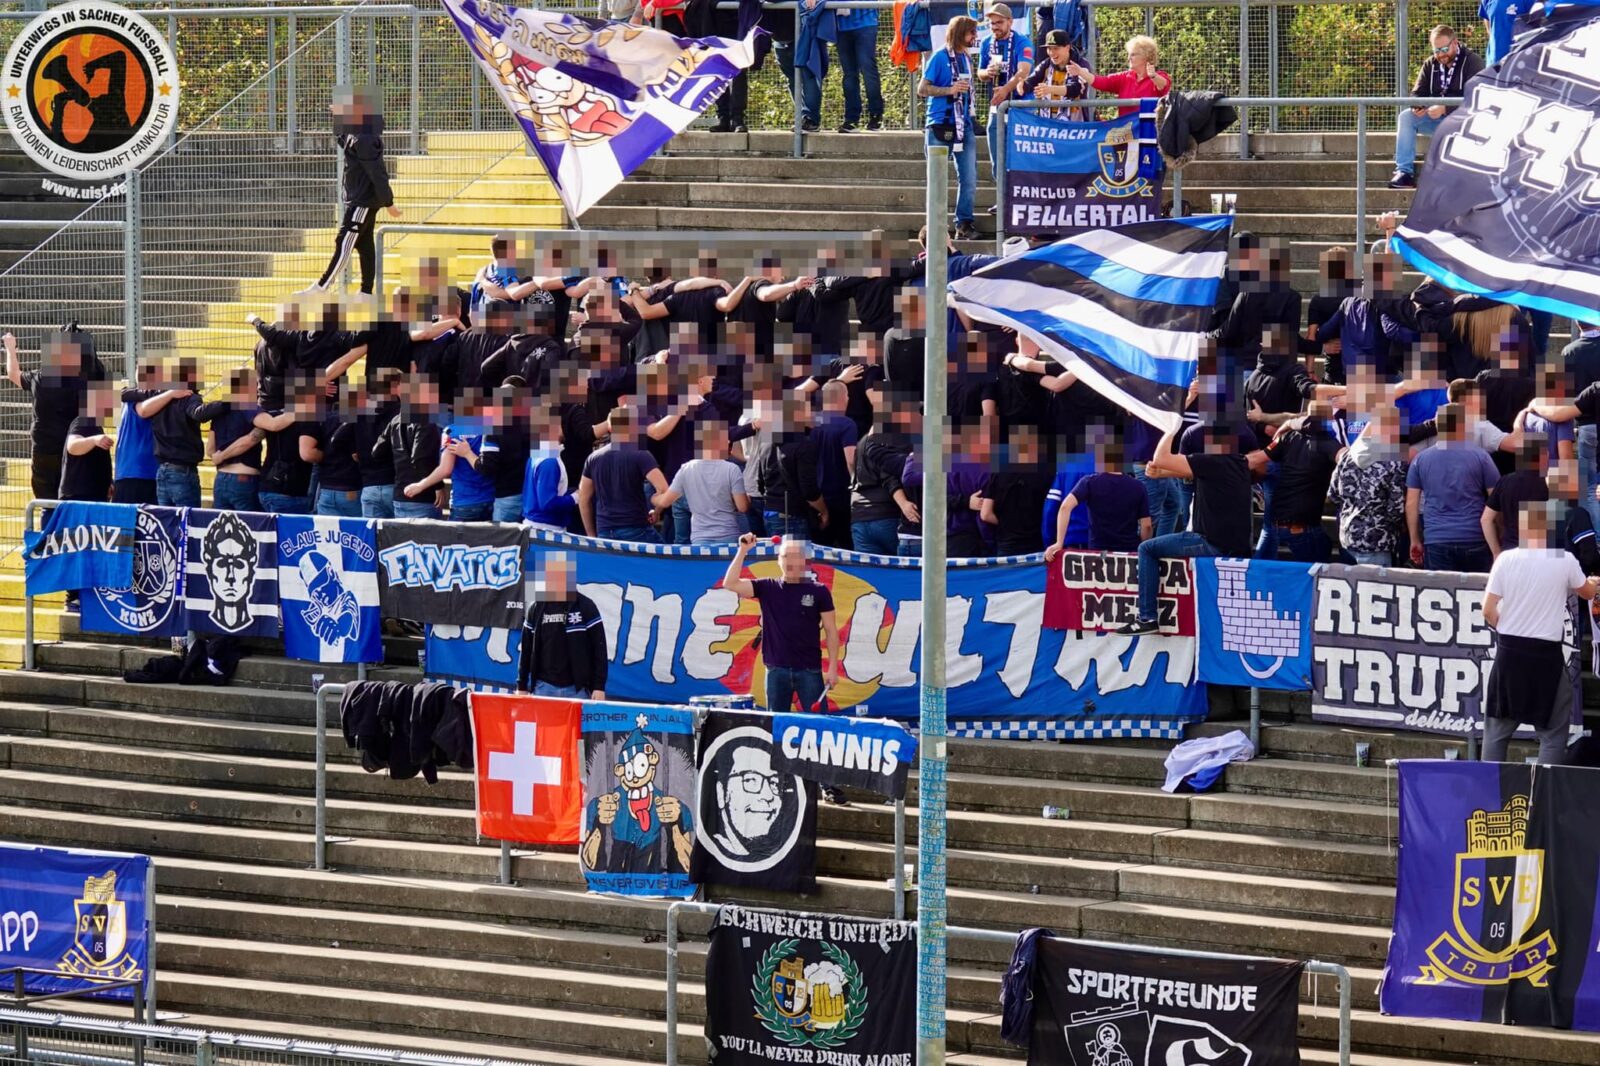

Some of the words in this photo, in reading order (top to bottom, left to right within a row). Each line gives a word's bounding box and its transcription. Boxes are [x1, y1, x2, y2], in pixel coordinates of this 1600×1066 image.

[1014, 123, 1097, 140] EINTRACHT
[1014, 140, 1055, 155] TRIER
[1013, 185, 1077, 199] FANCLUB
[1011, 204, 1155, 227] FELLERTAL
[279, 530, 322, 558] BLAUE
[325, 530, 375, 562] JUGEND
[120, 608, 157, 626] KONZ
[1082, 591, 1179, 634] MEZ
[1313, 645, 1495, 715] TRUP
[1405, 709, 1475, 732] delikat
[782, 726, 901, 776] CANNIS
[719, 906, 824, 940] SCHWEICH
[829, 920, 908, 943] UNITED
[1489, 922, 1505, 938] 05
[94, 942, 104, 953] 05
[1067, 967, 1258, 1012] SPORTFREUNDE
[719, 1034, 765, 1057] YOU'LL
[765, 1045, 814, 1064] NEVER
[816, 1050, 862, 1066] DRINK
[866, 1053, 912, 1066] ALONE
